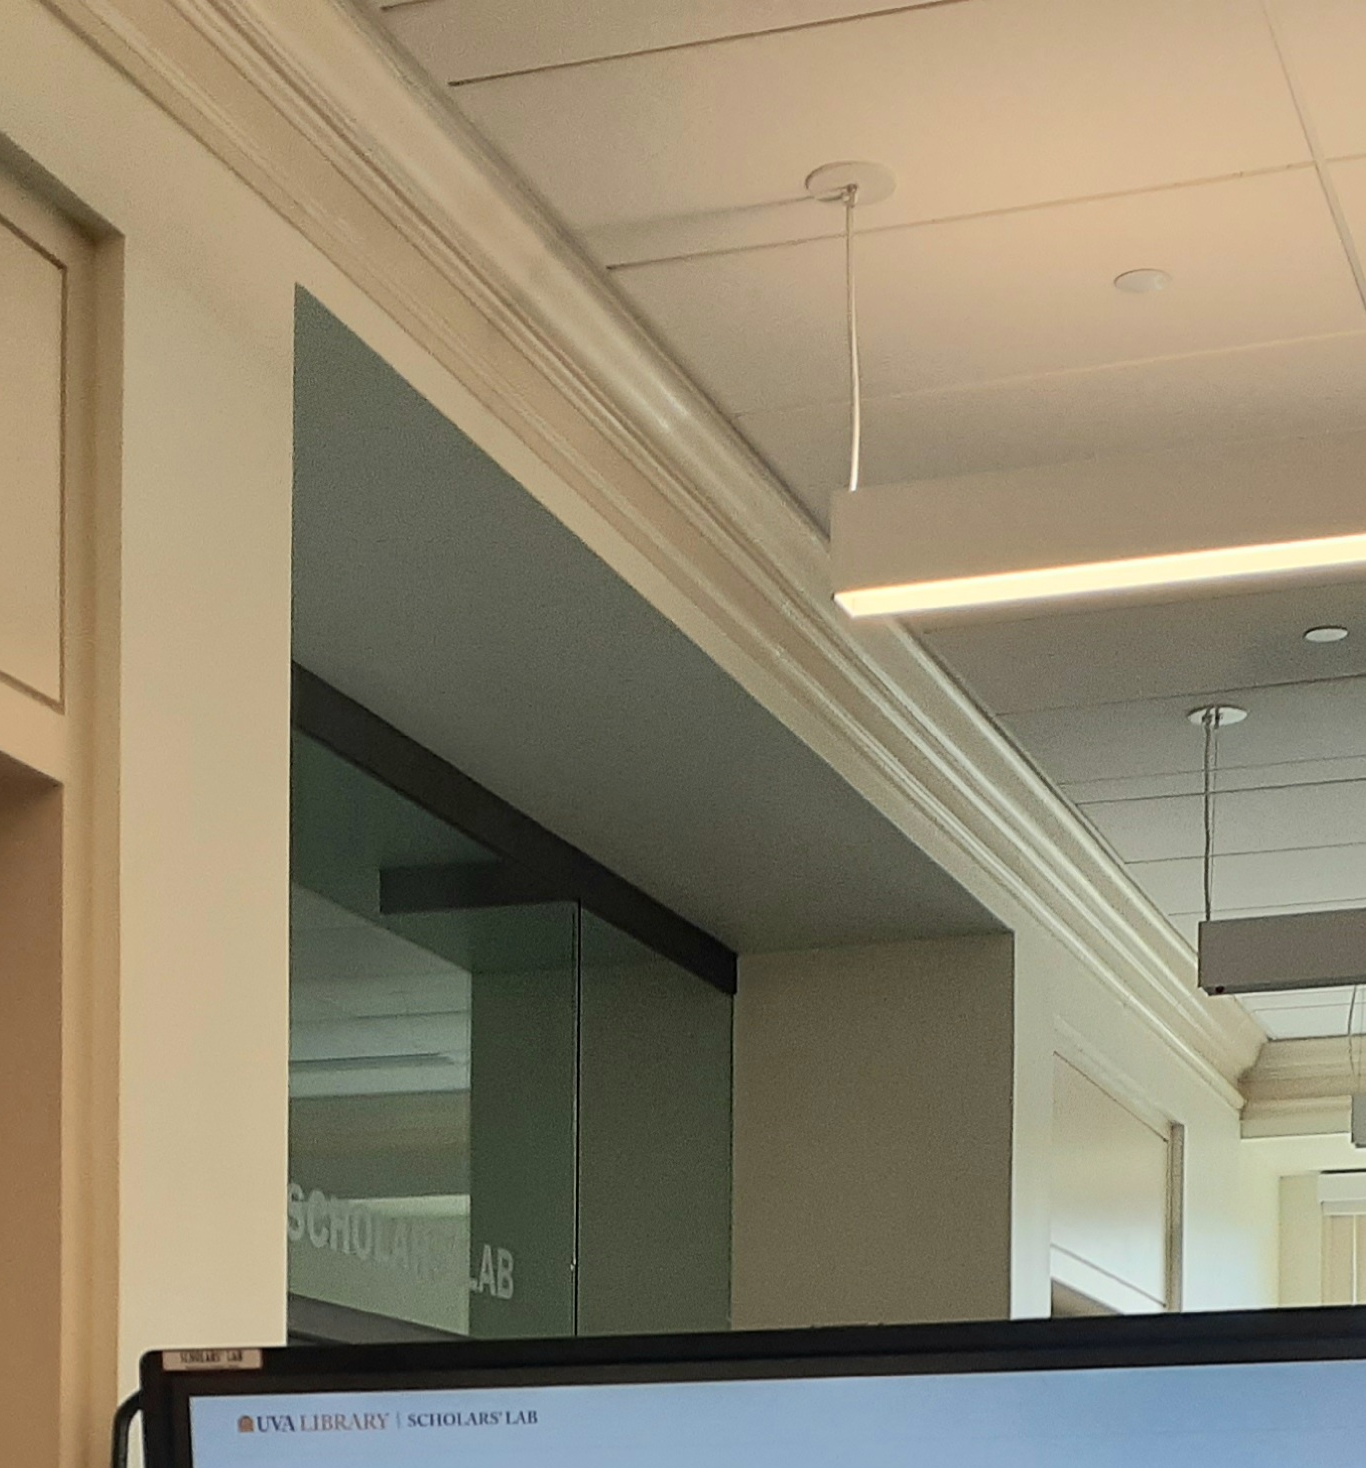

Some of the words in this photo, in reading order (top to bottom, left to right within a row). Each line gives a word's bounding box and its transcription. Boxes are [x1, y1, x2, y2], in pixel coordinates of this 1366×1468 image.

[257, 1415, 296, 1432] UVA
[300, 1413, 390, 1431] LIBRARY
[407, 1411, 503, 1428] SCHOLARS'
[505, 1410, 538, 1426] LAB
